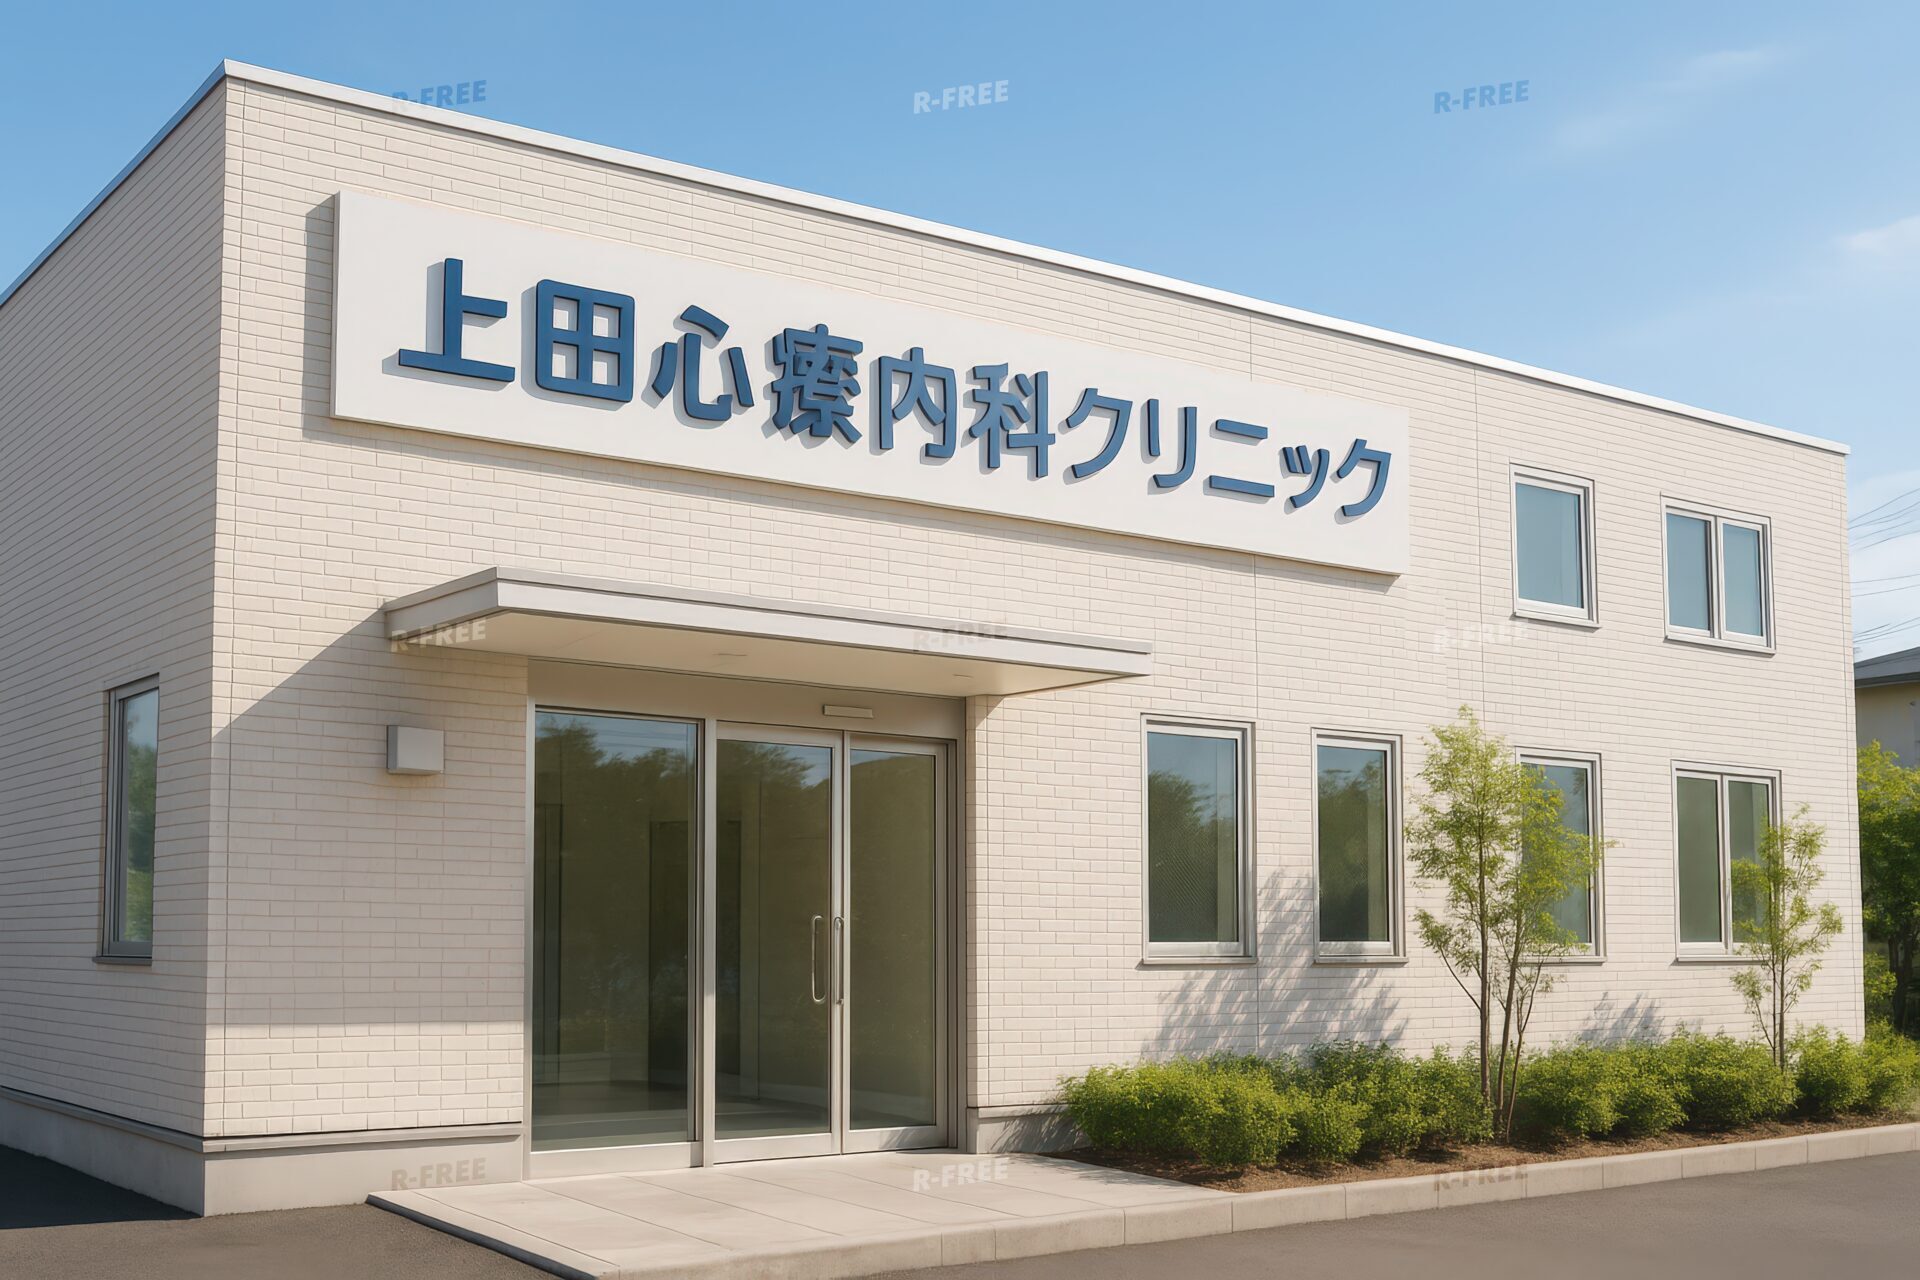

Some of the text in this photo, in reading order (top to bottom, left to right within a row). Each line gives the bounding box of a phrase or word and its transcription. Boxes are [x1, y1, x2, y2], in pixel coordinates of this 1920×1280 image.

[398, 257, 1392, 518] 上田心療内科クリニック
